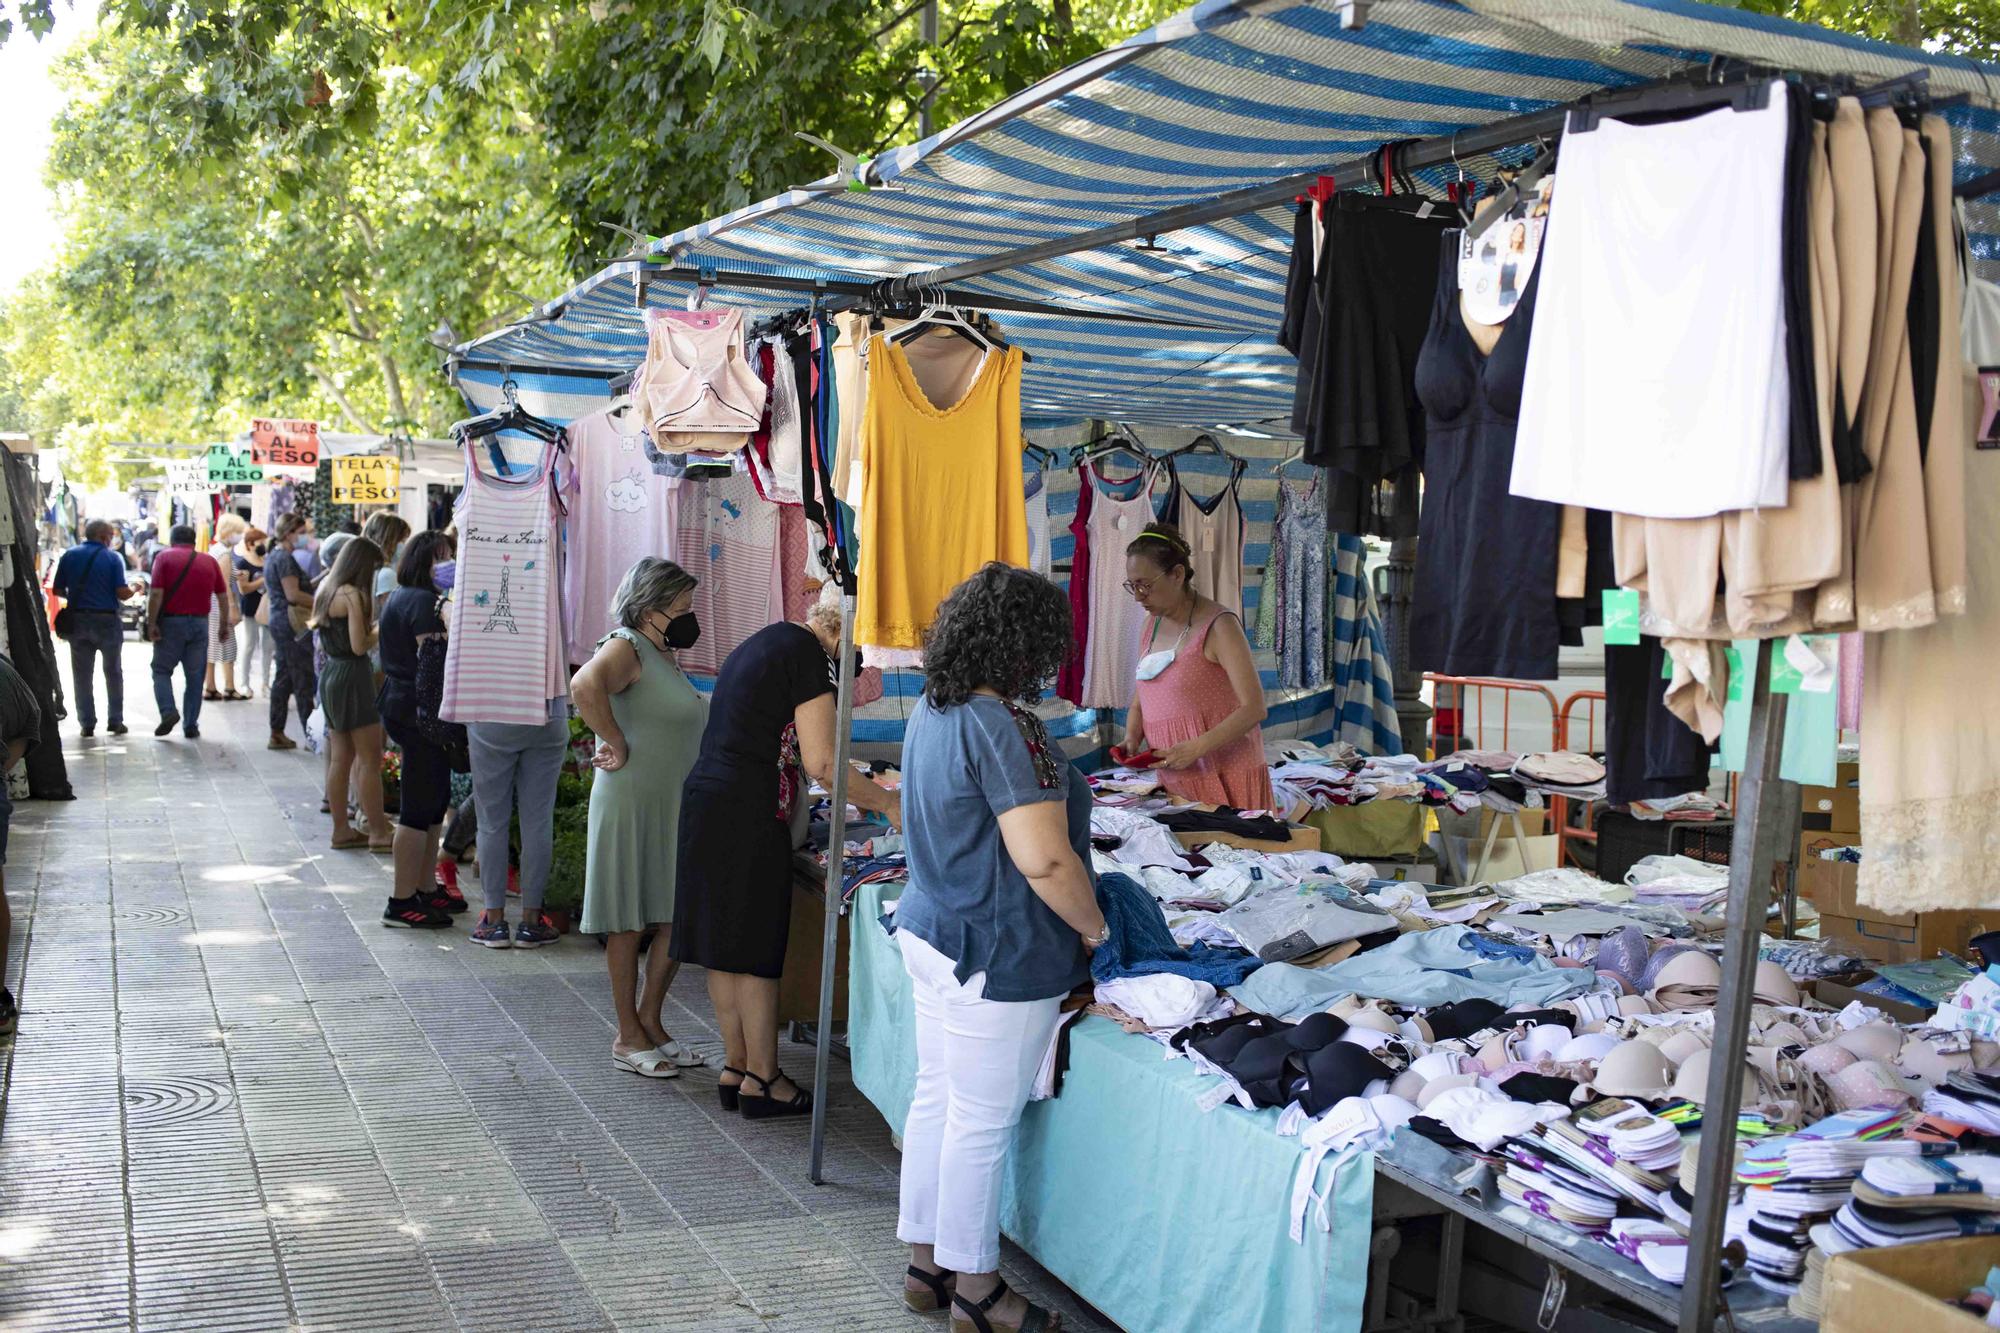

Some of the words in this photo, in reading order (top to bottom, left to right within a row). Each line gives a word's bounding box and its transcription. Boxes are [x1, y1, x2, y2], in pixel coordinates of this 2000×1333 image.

[270, 436, 296, 448] AL
[227, 457, 246, 468] AL
[253, 449, 317, 464] PESO
[209, 469, 264, 481] PESO
[352, 473, 376, 485] AL
[335, 487, 397, 499] PESO
